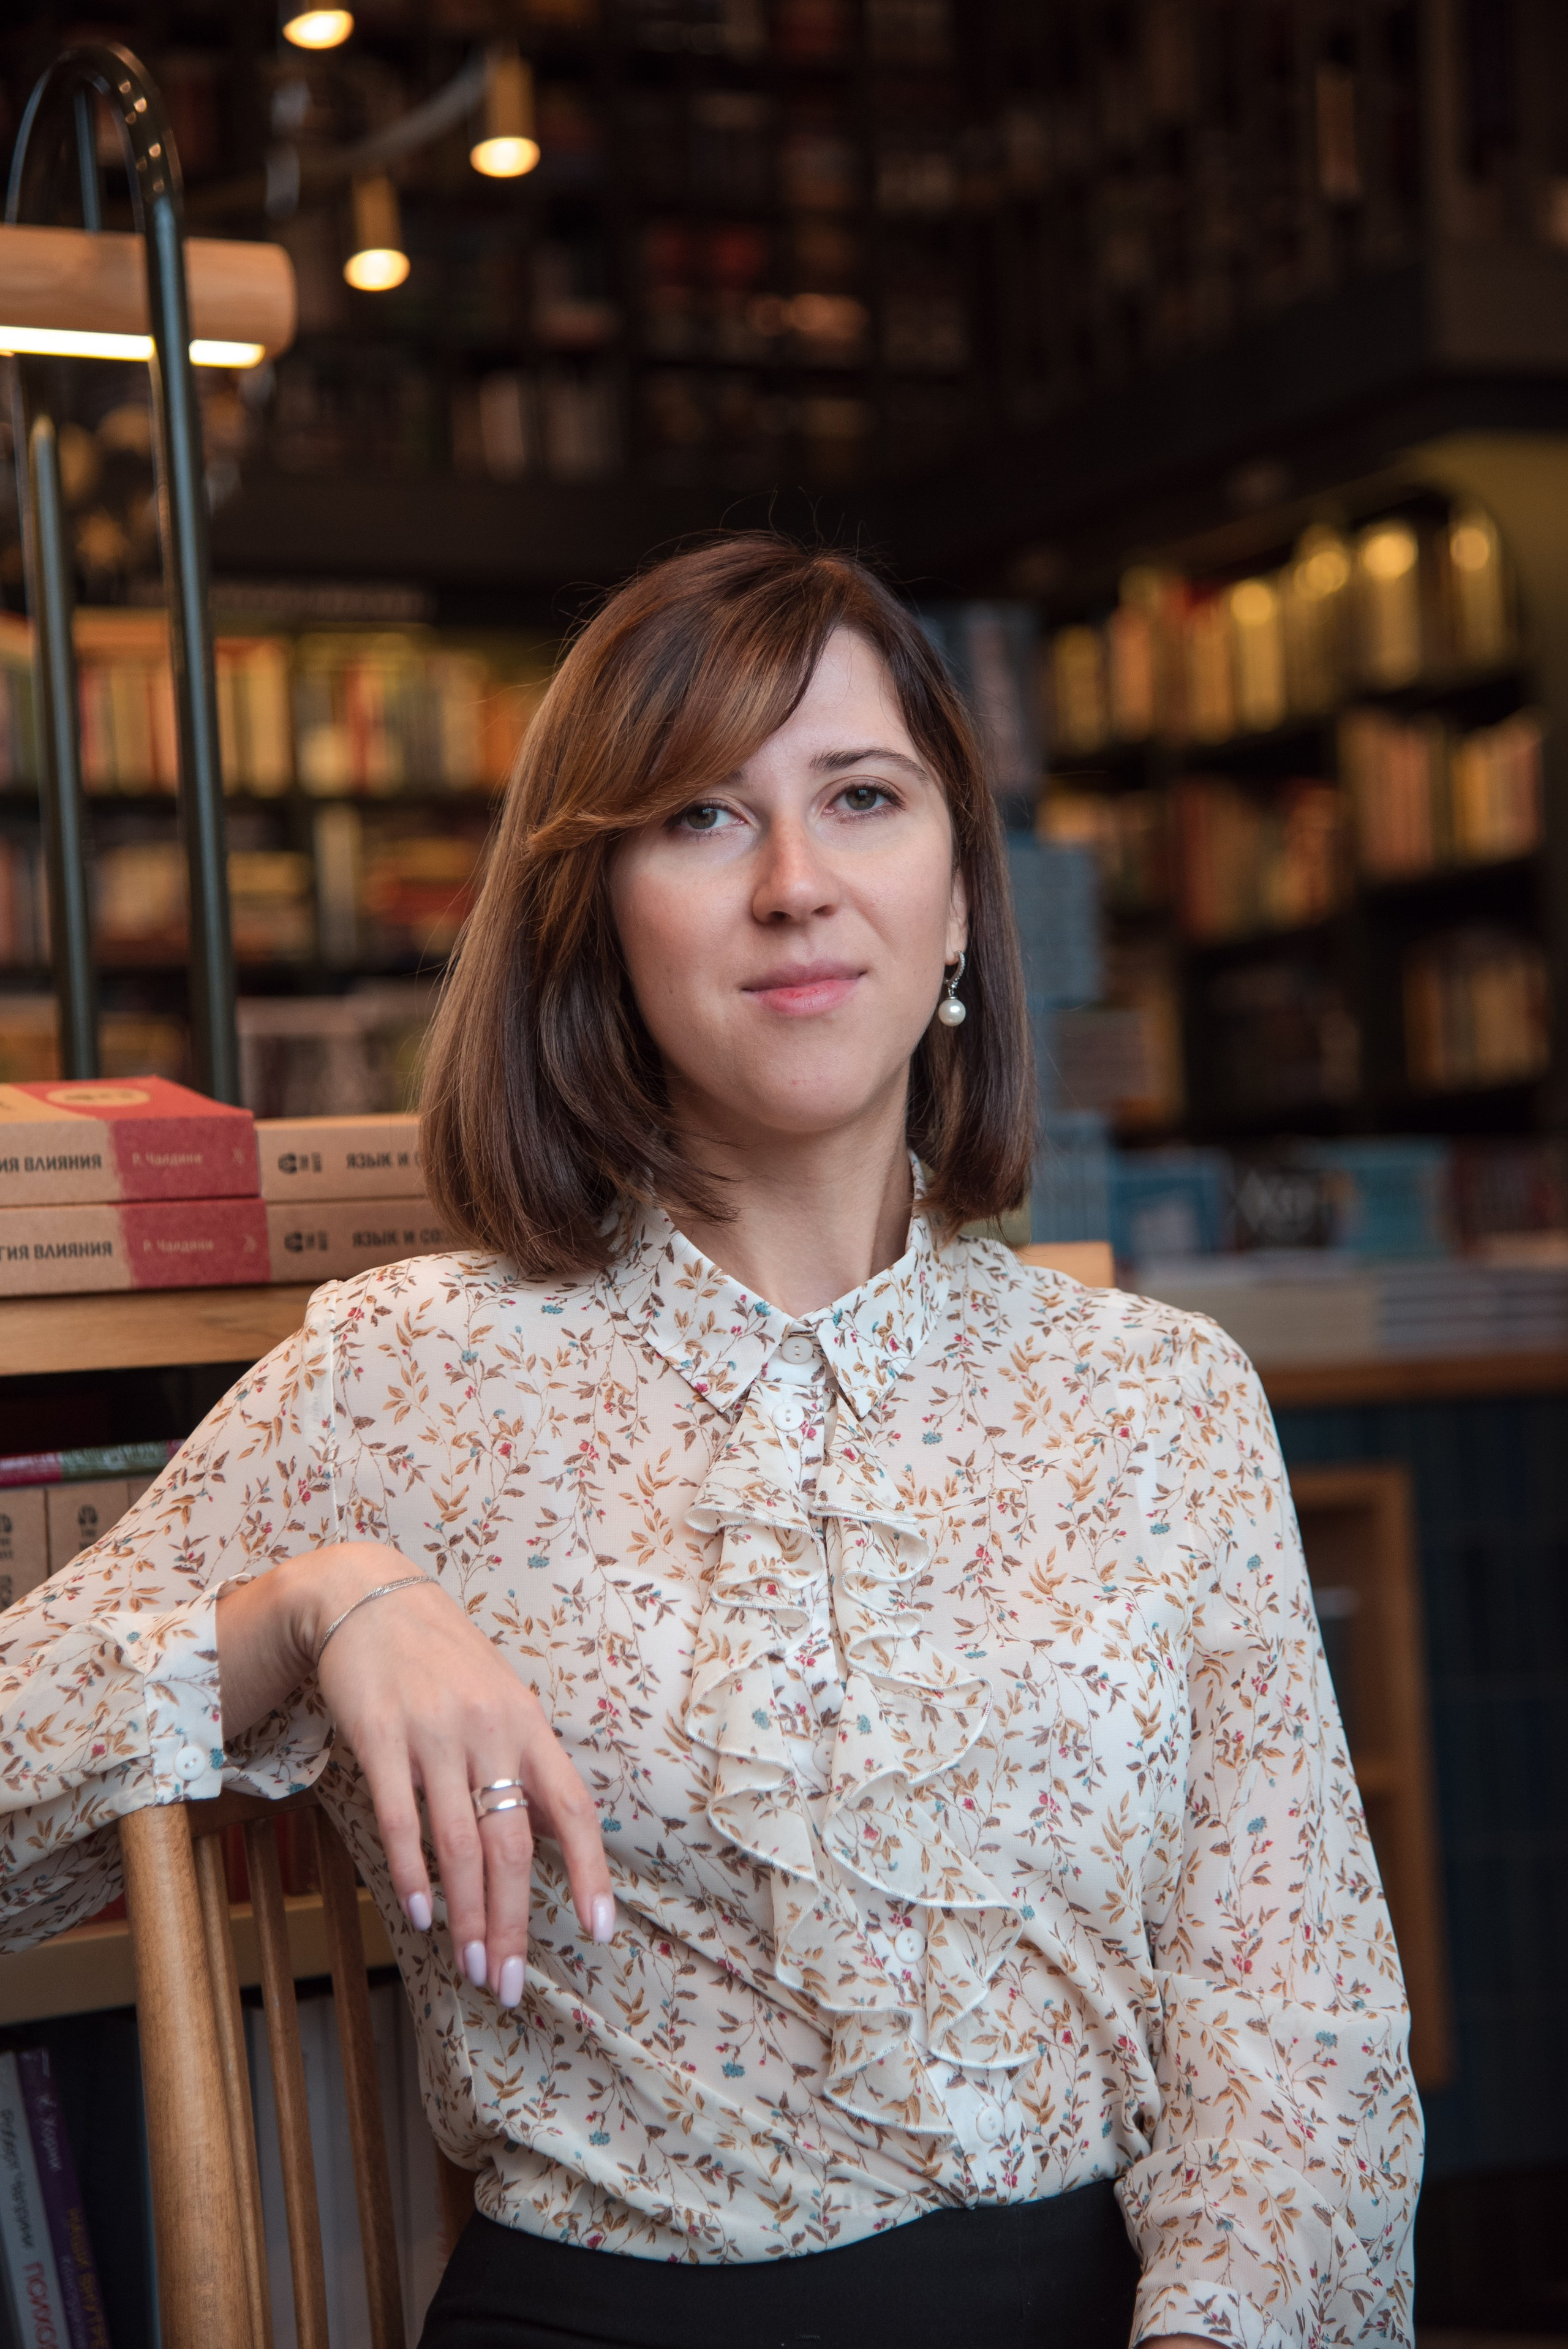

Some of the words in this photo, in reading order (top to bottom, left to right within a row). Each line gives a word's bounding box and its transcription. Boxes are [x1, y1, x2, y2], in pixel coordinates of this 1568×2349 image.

[24, 1153, 102, 1172] ВЛИЯНИЯ
[346, 1152, 391, 1169] ЯЗЫК
[352, 1229, 398, 1247] ЯЗЫК
[34, 1241, 113, 1260] ВЛИЯНИЯ
